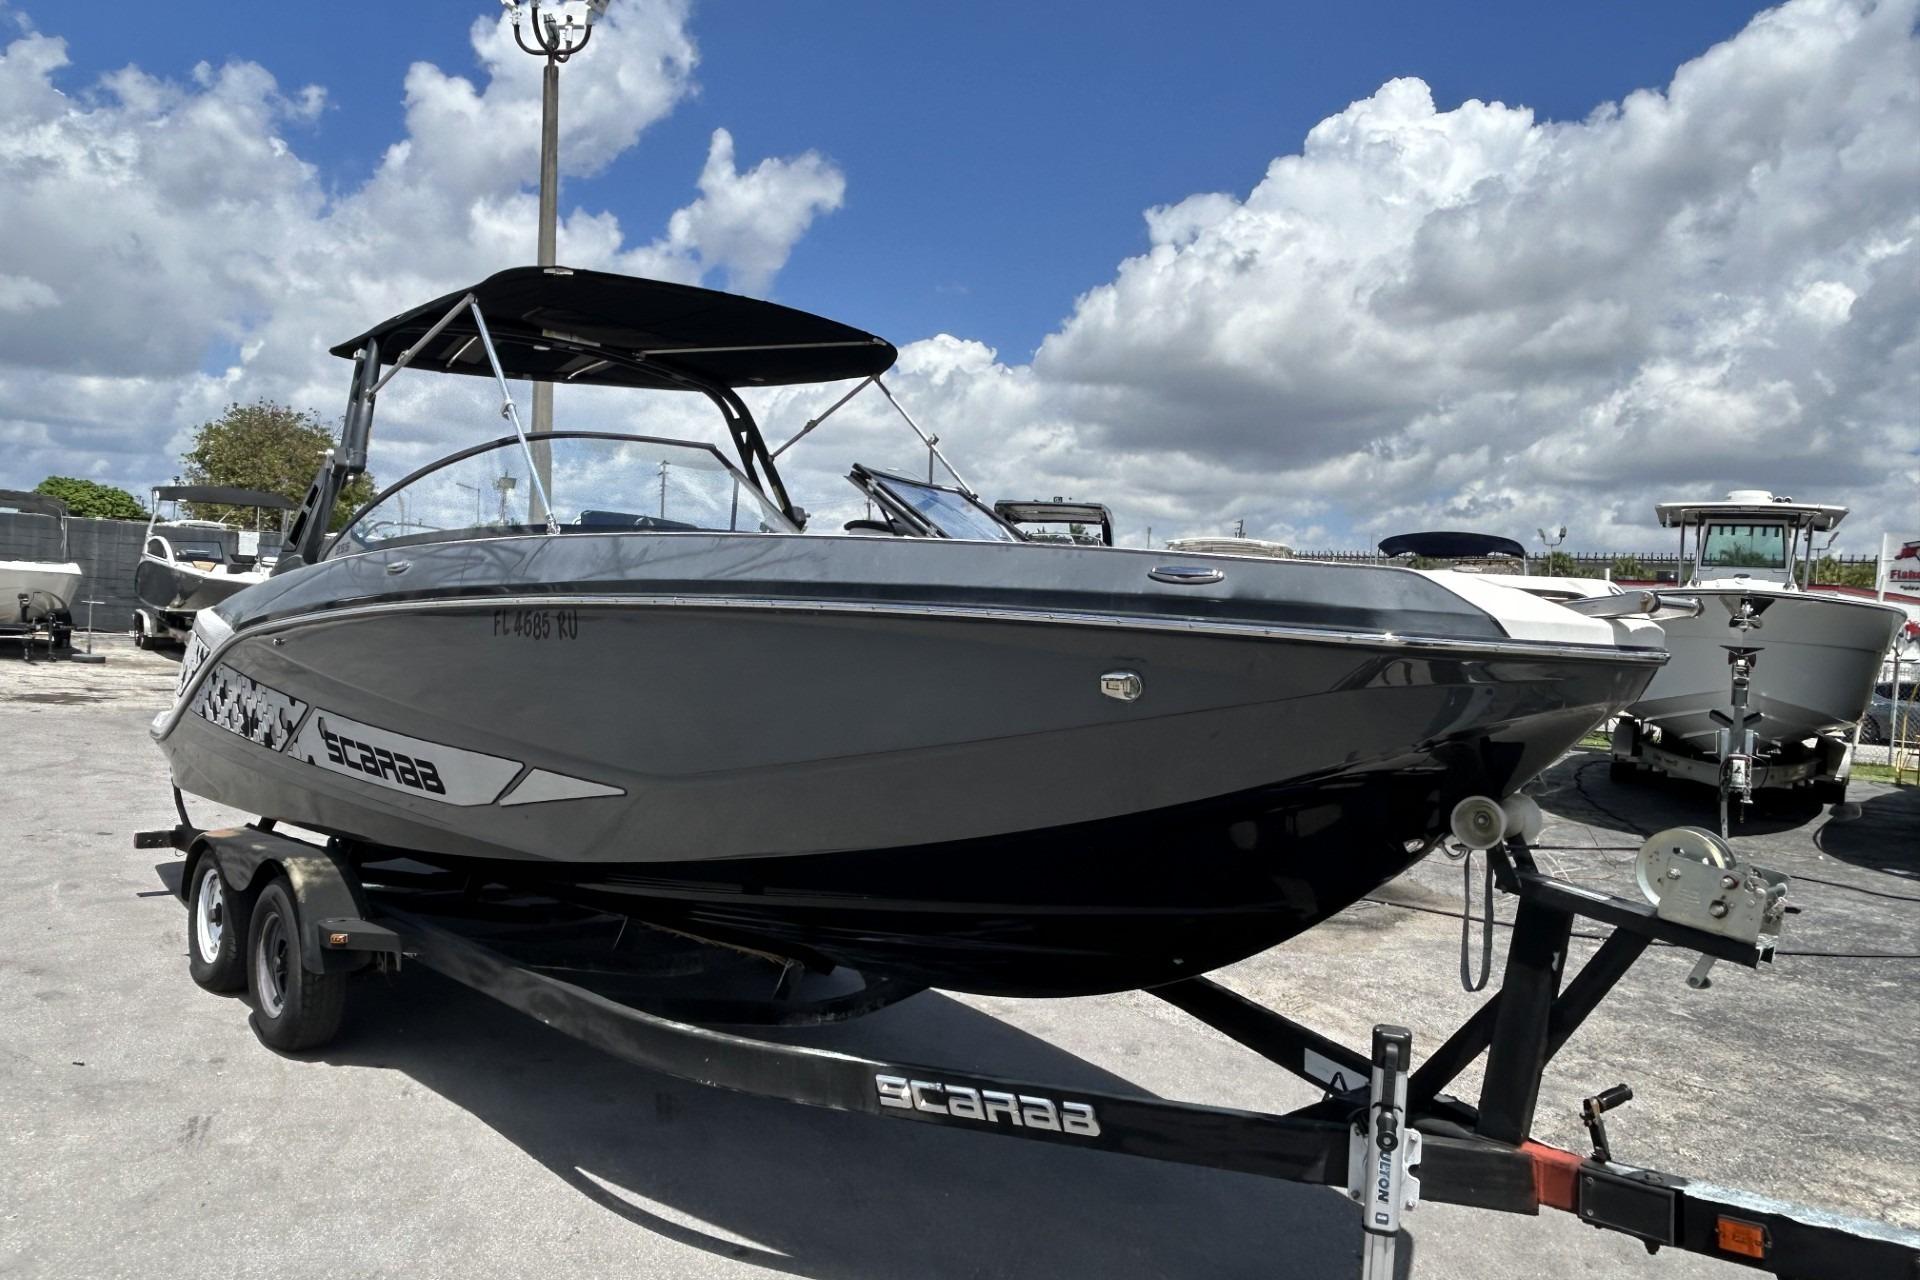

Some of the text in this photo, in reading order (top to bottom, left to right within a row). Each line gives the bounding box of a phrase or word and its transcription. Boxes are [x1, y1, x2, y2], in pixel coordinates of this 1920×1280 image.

[494, 608, 578, 640] FL 4685 RU
[323, 728, 446, 795] SCARAB
[875, 1074, 1101, 1137] SCARAB
[1377, 1149, 1392, 1204] ULTON
